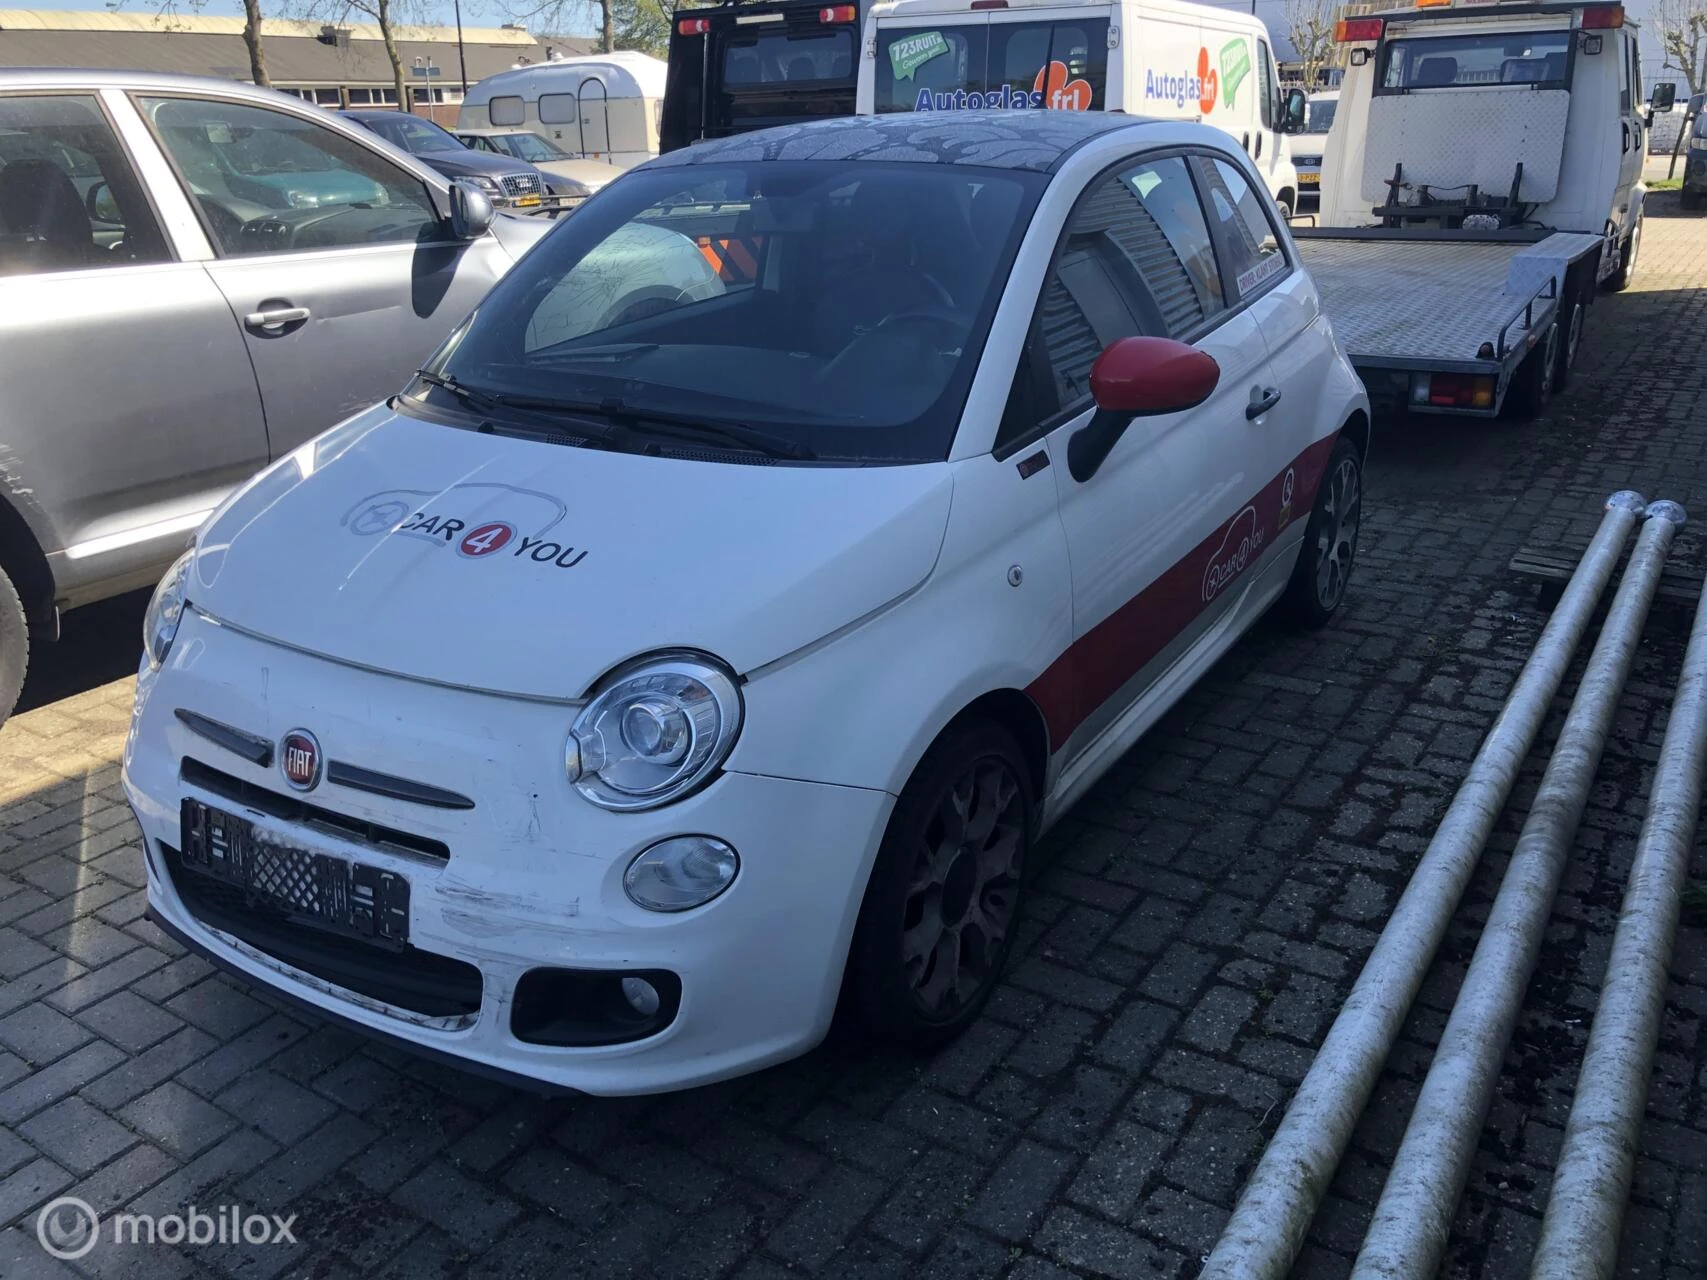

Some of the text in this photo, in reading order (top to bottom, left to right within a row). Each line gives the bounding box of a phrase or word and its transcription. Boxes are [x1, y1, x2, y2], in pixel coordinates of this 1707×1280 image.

[400, 512, 588, 568] CAR 4 YOU
[288, 746, 312, 777] FIAT
